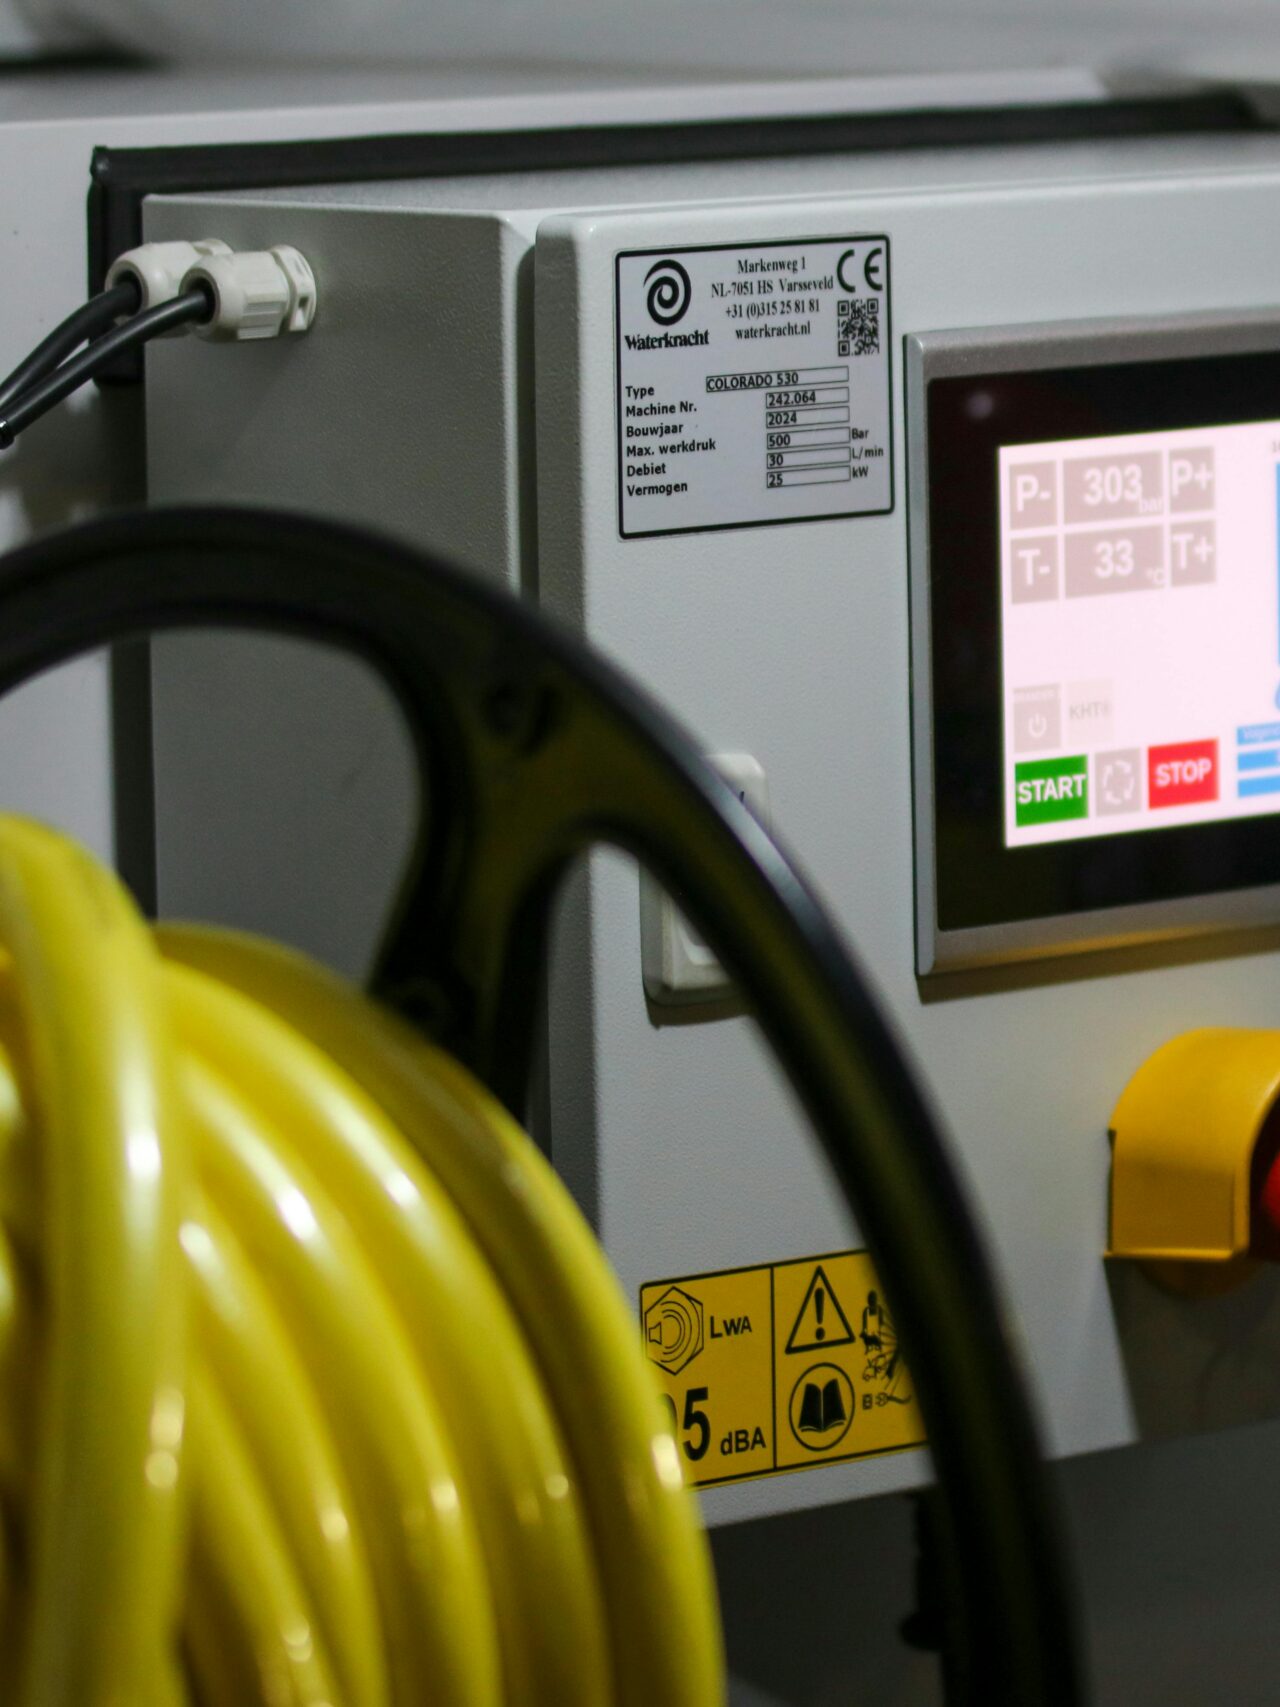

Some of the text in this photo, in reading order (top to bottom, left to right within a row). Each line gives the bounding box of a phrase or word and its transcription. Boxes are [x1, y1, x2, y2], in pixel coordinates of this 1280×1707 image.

[737, 257, 806, 275] Markenweg 1
[711, 275, 834, 298] NL-7051 HS Varsseveld
[725, 298, 820, 319] +31 (0)315 25 81 81
[624, 329, 710, 351] Waterkracht
[735, 323, 811, 340] waterkracht.nl
[625, 372, 799, 398] Type COLORADO 530
[626, 391, 816, 417] Machine Nr. 242.064
[626, 412, 798, 438] Bouwjaar 2024
[626, 428, 869, 457] Max. werkdruk 500 Bar
[627, 447, 884, 477] Debiet 30 L/min
[627, 467, 869, 498] Vermogen 25 kW
[1082, 464, 1143, 507] 303
[1171, 460, 1214, 496] P+
[1014, 474, 1052, 512] P-
[1095, 539, 1135, 579] 33
[1173, 532, 1214, 570] T+
[1018, 548, 1051, 586] T-
[1155, 756, 1212, 788] STOP
[1017, 774, 1087, 805] START
[720, 1426, 767, 1455] dBA
